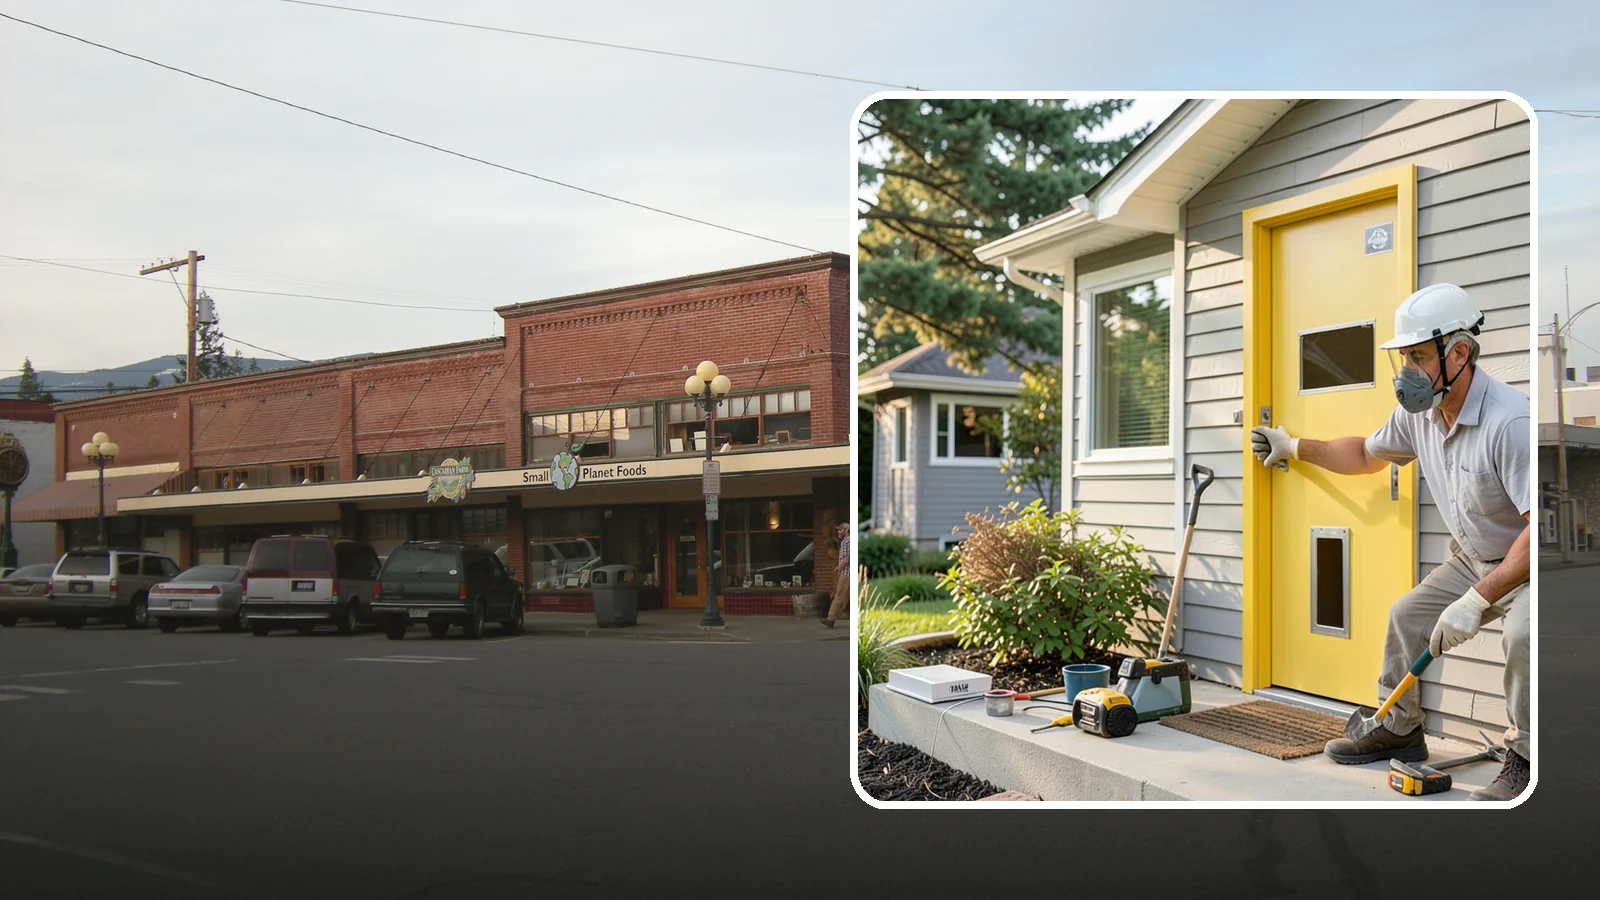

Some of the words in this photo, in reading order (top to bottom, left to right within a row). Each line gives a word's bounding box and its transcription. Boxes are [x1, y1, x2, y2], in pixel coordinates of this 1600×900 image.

[431, 466, 456, 476] CASCADIAN
[456, 466, 469, 475] FARM
[523, 471, 549, 483] Small
[583, 467, 614, 479] Planet
[617, 464, 647, 477] Foods
